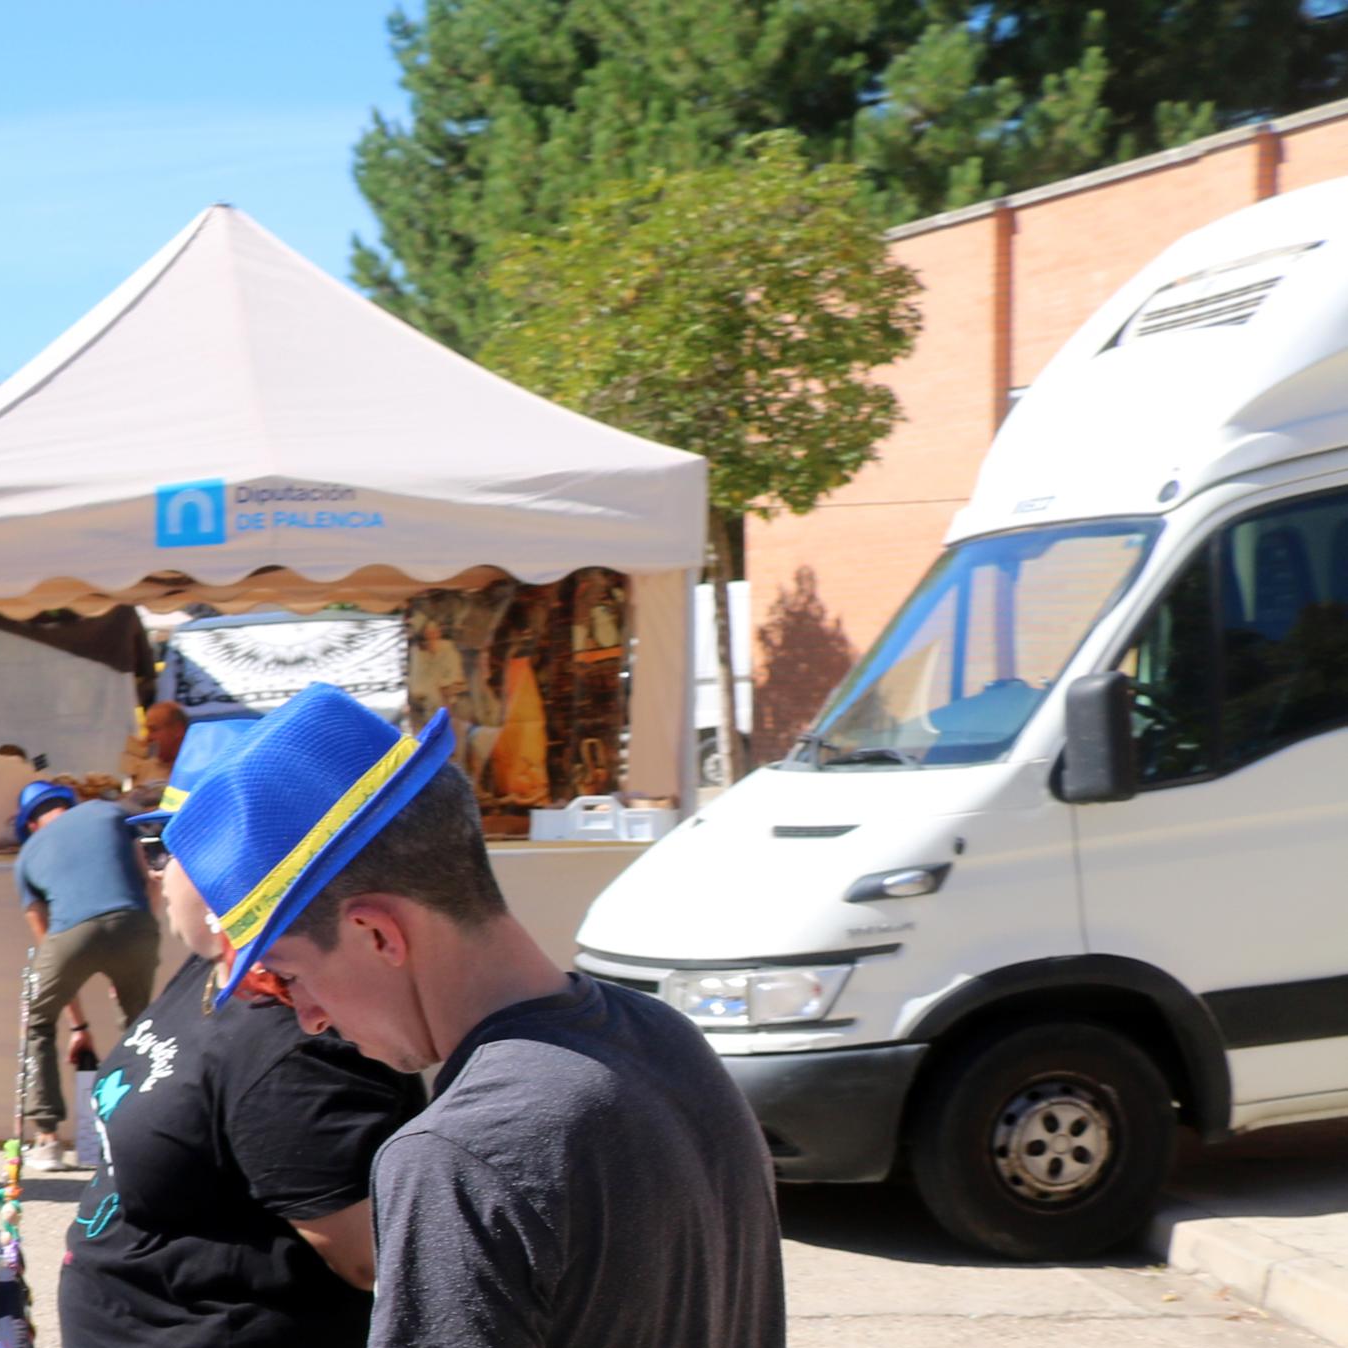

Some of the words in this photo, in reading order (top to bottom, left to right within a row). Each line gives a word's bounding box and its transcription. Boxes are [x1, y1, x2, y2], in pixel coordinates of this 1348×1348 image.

[235, 485, 356, 504] Diputación
[236, 512, 266, 531] DE
[272, 511, 385, 528] PALENCIA
